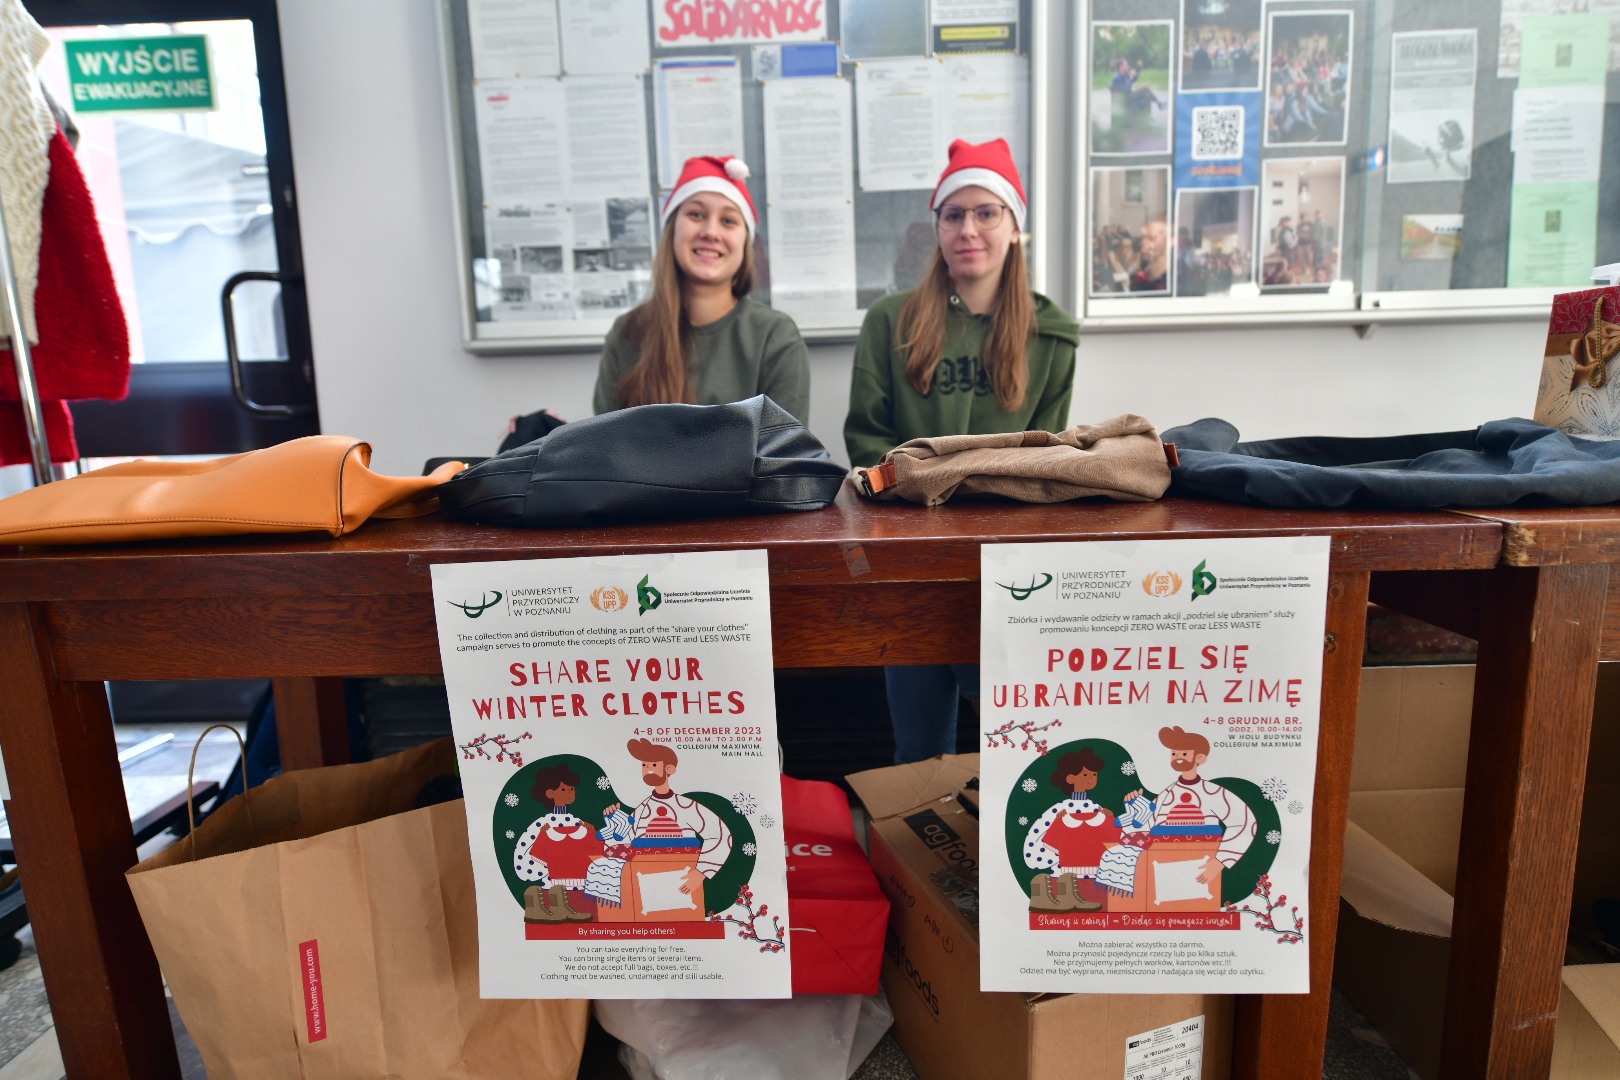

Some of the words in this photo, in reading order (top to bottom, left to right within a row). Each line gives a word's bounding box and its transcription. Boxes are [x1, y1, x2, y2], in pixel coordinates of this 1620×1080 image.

[75, 45, 200, 76] WYJŚCIE
[74, 78, 209, 101] EWAKUACYJNE
[1062, 570, 1126, 580] UNIWERSYTET
[1155, 575, 1169, 584] KSS
[1061, 580, 1131, 590] PRZYRODNICZY
[511, 586, 573, 597] UNIWERSYTET
[602, 591, 616, 599] KSS
[1073, 591, 1121, 600] POZNANIU
[1154, 585, 1170, 596] UPP
[512, 596, 579, 606] PRZYRODNICZY
[603, 600, 618, 610] UPP
[525, 606, 571, 616] POZNANIU
[1008, 616, 1038, 624] Zbiórka
[1044, 614, 1089, 624] wydawanie
[1090, 613, 1121, 622] odzieży
[1132, 613, 1161, 621] ramach
[1163, 612, 1181, 621] akcji
[1217, 611, 1229, 620] się
[1040, 625, 1089, 634] promowaniu
[1091, 624, 1128, 632] koncepcji
[1130, 623, 1154, 631] ZERO
[1156, 622, 1187, 630] WASTE
[1208, 621, 1228, 630] LESS
[1230, 621, 1261, 629] WASTE
[474, 632, 512, 641] collection
[514, 630, 528, 639] and
[530, 629, 574, 637] distribution
[576, 628, 584, 636] of
[586, 627, 618, 635] clothing
[629, 628, 646, 637] part
[646, 627, 655, 635] of
[656, 627, 670, 635] the
[697, 627, 715, 636] your
[456, 643, 494, 651] campaign
[532, 640, 565, 648] promote
[581, 638, 616, 646] concepts
[652, 635, 681, 643] WASTE
[683, 635, 697, 643] and
[699, 634, 719, 643] LESS
[720, 633, 750, 642] WASTE
[1048, 646, 1184, 672] PODZIEL
[1200, 645, 1249, 674] SIĘ
[509, 659, 611, 686] SHARE
[626, 657, 703, 682] YOUR
[993, 681, 1149, 708] UBRANIEM
[1167, 680, 1208, 704] NA
[1223, 678, 1302, 708] ZIMĘ
[472, 694, 588, 720] WINTER
[602, 690, 745, 716] CLOTHES
[1227, 716, 1280, 725] GRUDNIA
[1284, 716, 1302, 725] BR.
[656, 727, 670, 735] OF
[674, 727, 731, 735] DECEMBER
[734, 726, 761, 735] 2023
[923, 824, 979, 872] agfoo
[1038, 914, 1071, 928] Sharing
[1081, 914, 1109, 928] caring!
[1155, 917, 1166, 926] się
[1168, 918, 1203, 928] pomagasz
[578, 928, 588, 936] By
[589, 927, 616, 936] sharing
[632, 927, 648, 936] help
[620, 946, 656, 954] everything
[1135, 941, 1167, 949] wszystko
[587, 955, 604, 963] bring
[606, 955, 626, 963] single
[1072, 950, 1106, 958] przynosić
[1107, 950, 1148, 958] pojedyncze
[600, 964, 623, 972] accept
[1067, 959, 1113, 967] przyjmujemy
[1114, 959, 1143, 967] pełnych
[1058, 967, 1071, 976] być
[1161, 968, 1193, 976] nadająca
[1239, 968, 1265, 976] użytku.
[540, 973, 568, 982] Clothing
[628, 973, 668, 981] undamaged
[670, 972, 683, 980] and
[686, 972, 697, 980] still
[306, 948, 321, 1034] www.home-you.com
[1181, 1022, 1199, 1035] 20404
